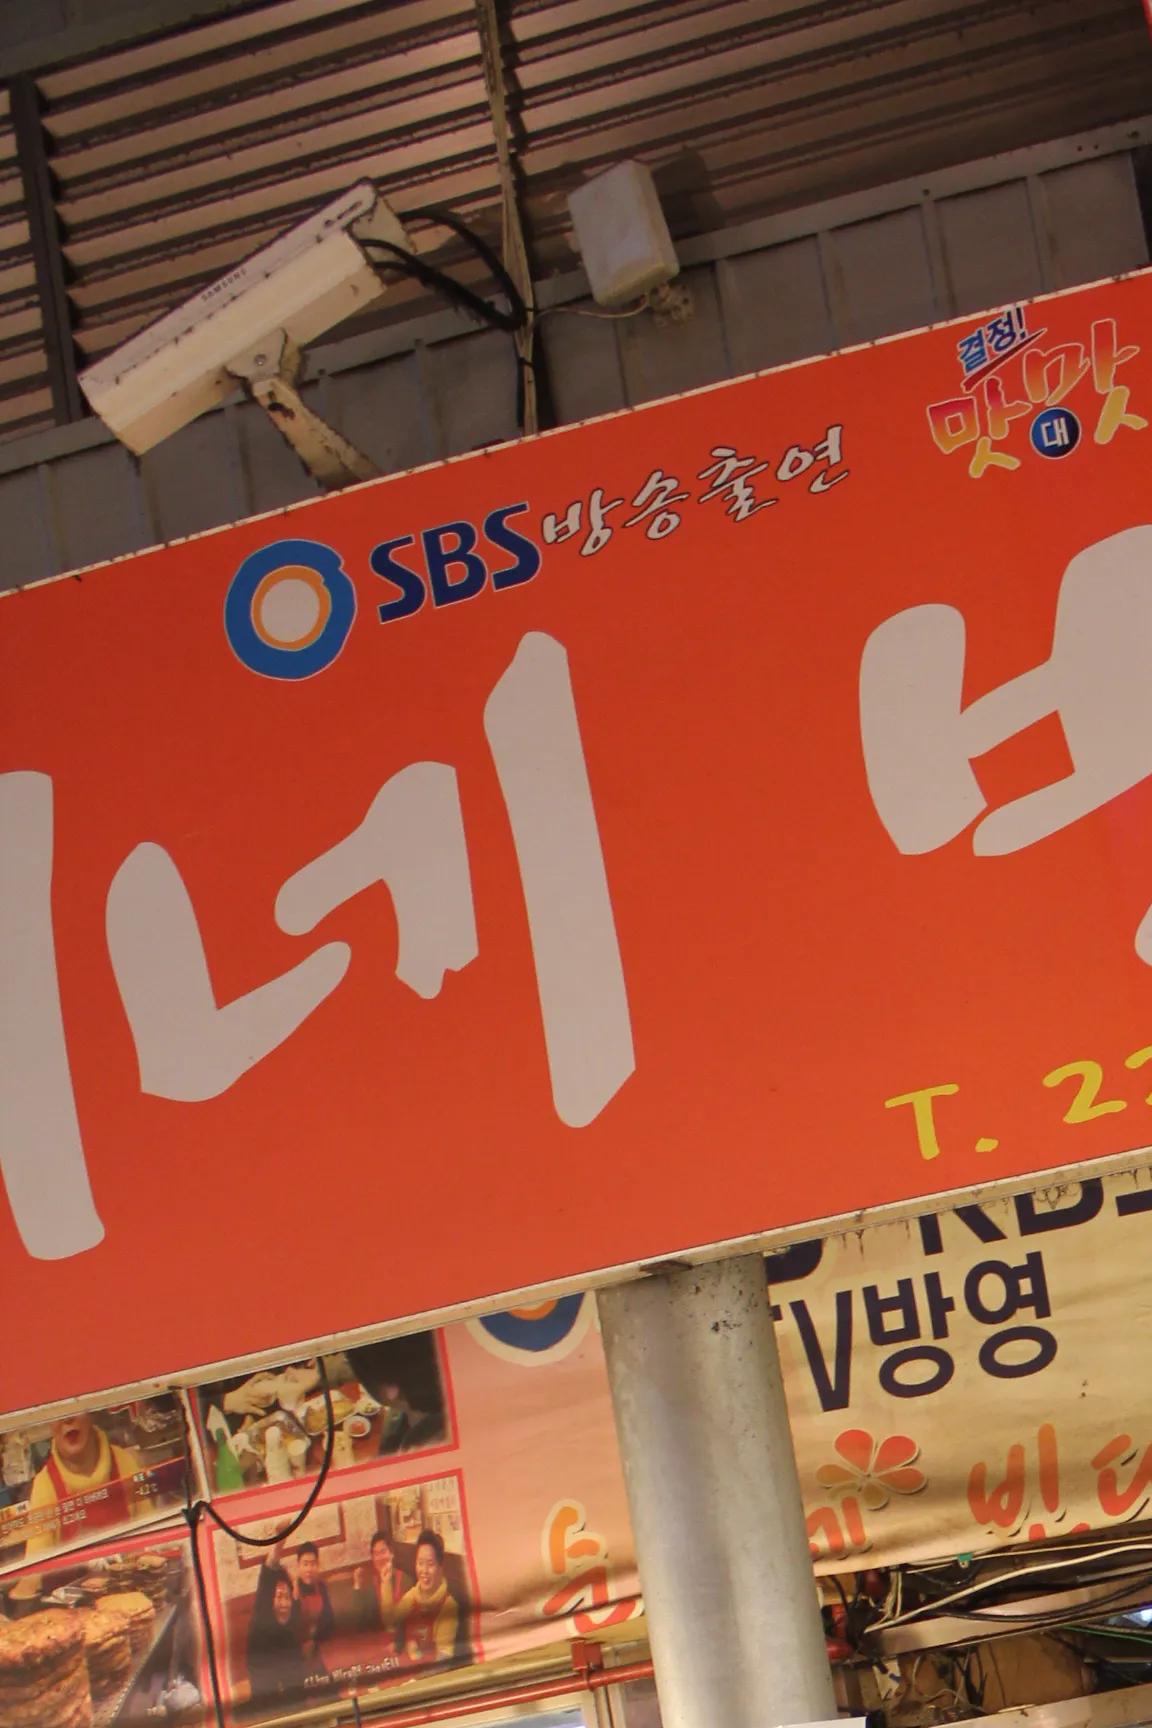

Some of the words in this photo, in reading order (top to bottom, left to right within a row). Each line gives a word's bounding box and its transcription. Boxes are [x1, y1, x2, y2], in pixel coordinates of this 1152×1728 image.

[957, 304, 1027, 374] 결정!
[369, 501, 541, 625] SBS
[0, 630, 637, 1262] 네
[885, 1083, 998, 1161] T.
[771, 1250, 1058, 1412] V방영
